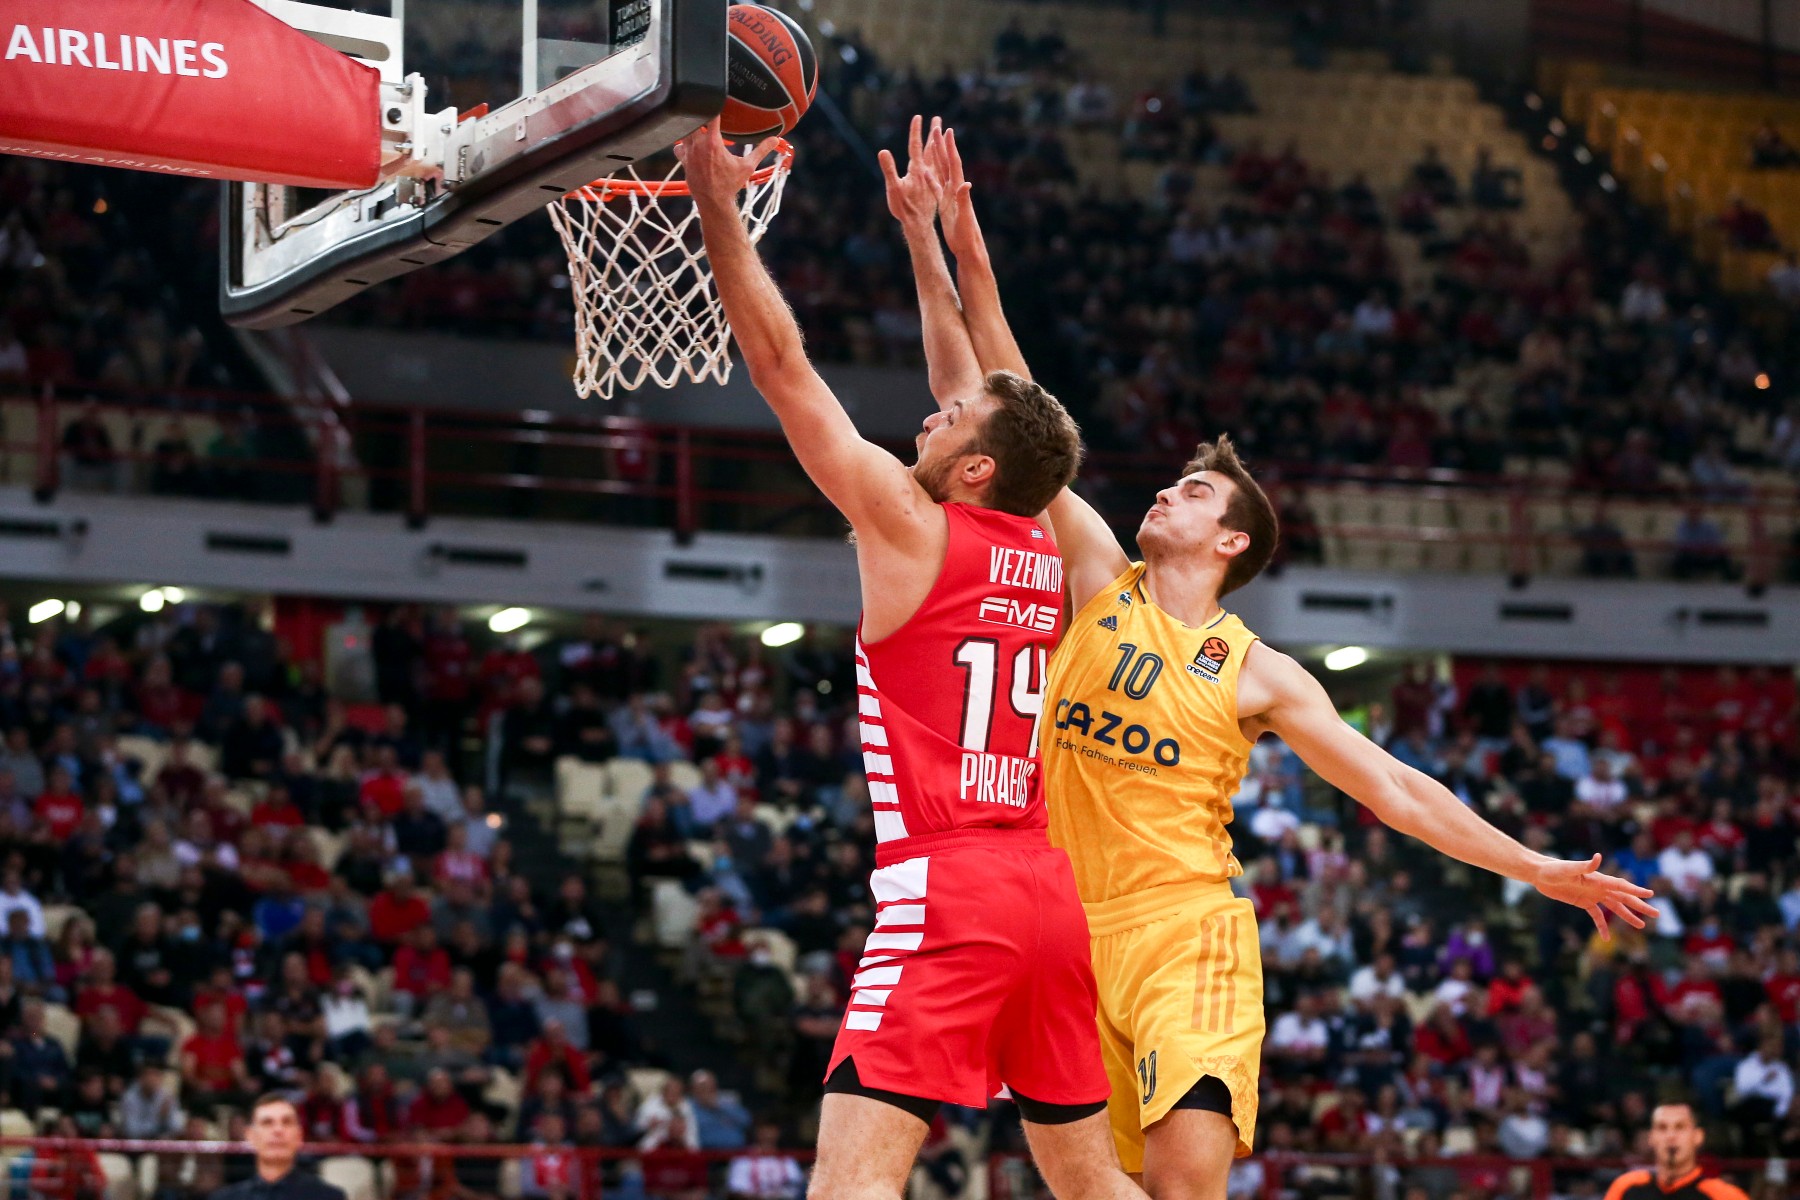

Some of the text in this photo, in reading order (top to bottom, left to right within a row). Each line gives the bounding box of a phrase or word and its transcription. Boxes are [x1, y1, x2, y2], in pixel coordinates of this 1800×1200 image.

[5, 24, 228, 79] AIRLINES
[84, 156, 212, 175] AIRLINES
[979, 596, 1059, 632] FMS
[952, 635, 1049, 759] 14
[1107, 641, 1164, 701] 10
[1055, 698, 1181, 767] CAZOO
[960, 752, 1036, 809] PIRAEUS
[1080, 745, 1117, 767] Fahren.
[1118, 758, 1159, 777] Freuen.
